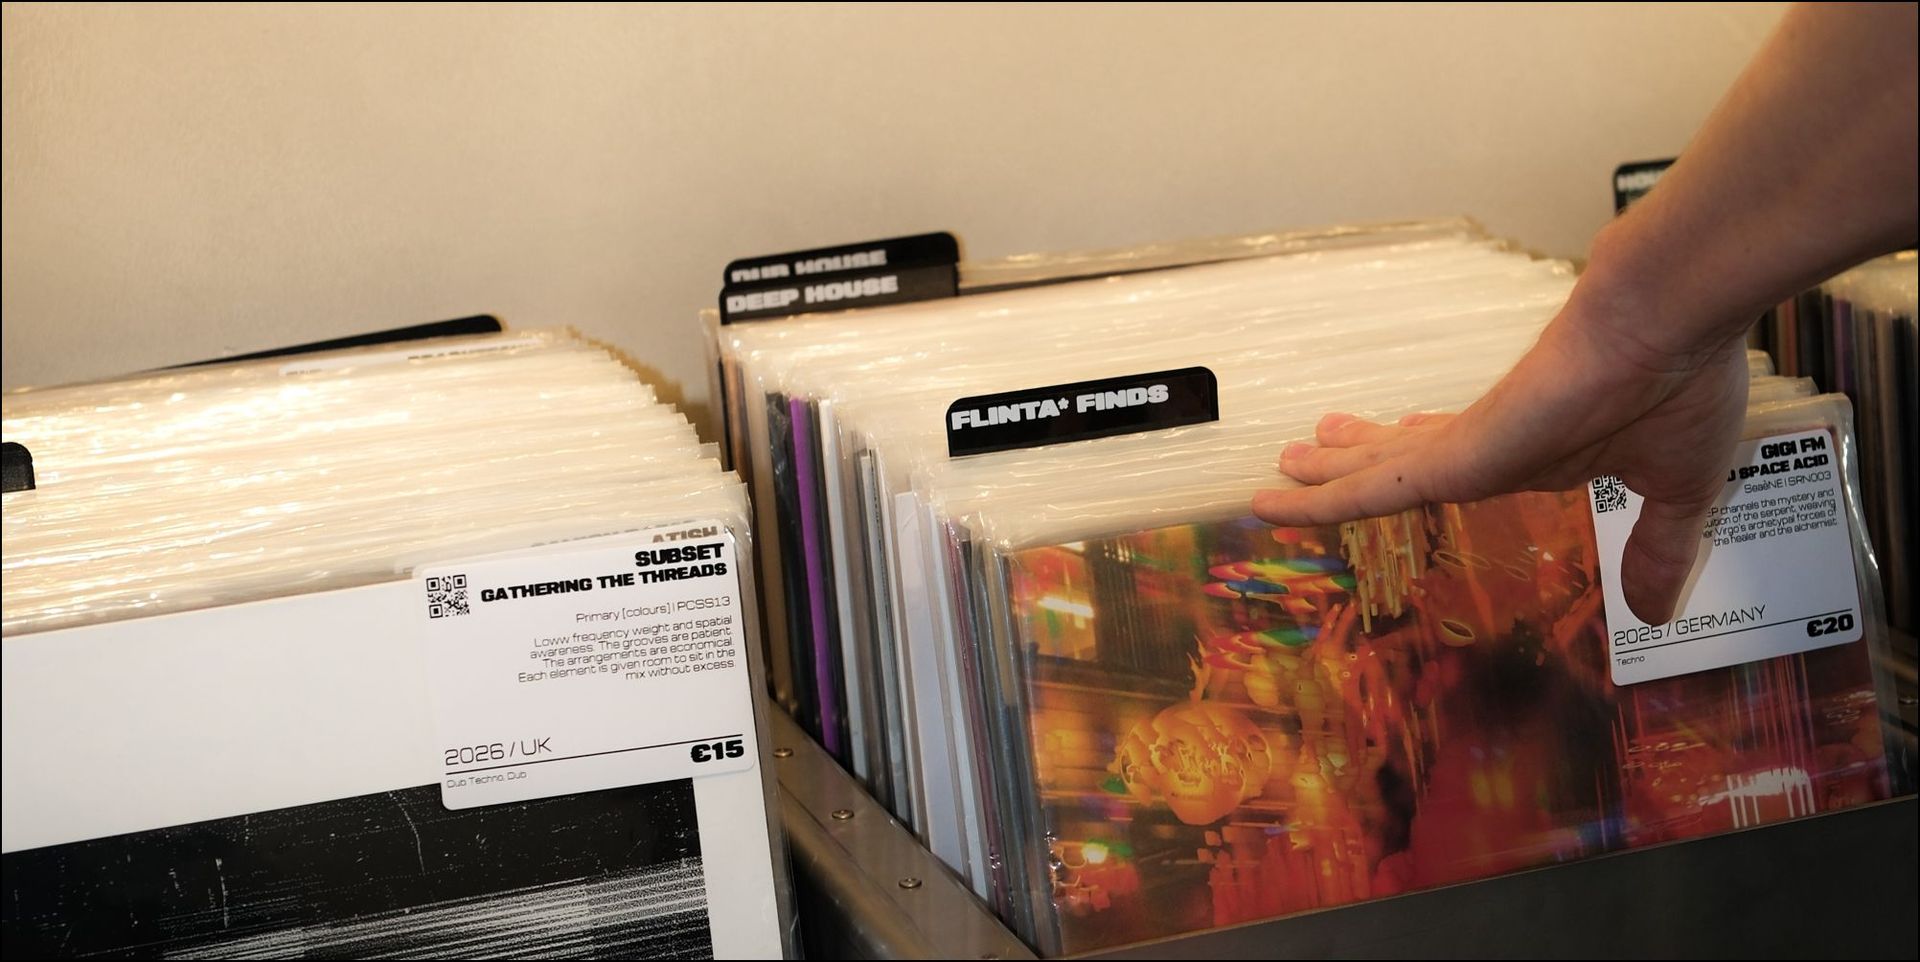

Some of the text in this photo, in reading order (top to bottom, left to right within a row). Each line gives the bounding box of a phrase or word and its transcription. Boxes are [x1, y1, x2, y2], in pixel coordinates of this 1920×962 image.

[795, 250, 887, 275] HOUSE
[726, 275, 898, 313] DEEP HOUSE
[1076, 384, 1169, 413] FINDS
[1761, 436, 1826, 459] GIGI FM
[1739, 460, 1790, 479] SPACE
[1793, 454, 1829, 470] ACID
[1720, 501, 1759, 515] channels
[1761, 498, 1776, 508] the
[1777, 491, 1816, 505] mystery
[1817, 488, 1835, 498] and
[1732, 512, 1742, 523] of
[1743, 510, 1759, 521] the
[1798, 499, 1836, 512] weaving
[1715, 524, 1746, 538] Virgo's
[1748, 516, 1796, 530] archetypal
[1796, 510, 1826, 521] forces
[1828, 507, 1838, 516] of
[1714, 537, 1730, 547] the
[1730, 532, 1757, 544] healer
[1759, 528, 1776, 539] and
[1777, 525, 1793, 535] the
[635, 543, 724, 567] SUBSET
[481, 563, 727, 602] GATHERING THE THREADS
[576, 610, 620, 623] Primary
[622, 602, 671, 620] [colours]
[677, 596, 731, 611] PCSS13
[572, 629, 630, 642] frequency
[632, 623, 670, 636] weight
[672, 620, 693, 631] and
[695, 615, 732, 629] spatial
[1614, 625, 1662, 646] 2025
[1675, 604, 1766, 635] GERMANY
[1806, 614, 1854, 638] €20
[598, 640, 620, 650] The
[622, 635, 669, 650] grooves
[671, 632, 689, 642] are
[518, 648, 735, 683] Each element is given room to sit in the
[542, 658, 565, 668] The
[567, 648, 647, 665] arrangements
[649, 646, 667, 656] are
[1616, 655, 1645, 666] Techno
[625, 671, 646, 680] mix
[648, 665, 691, 678] without
[445, 743, 505, 766] 2026
[520, 737, 552, 756] UK
[690, 739, 745, 763] €15
